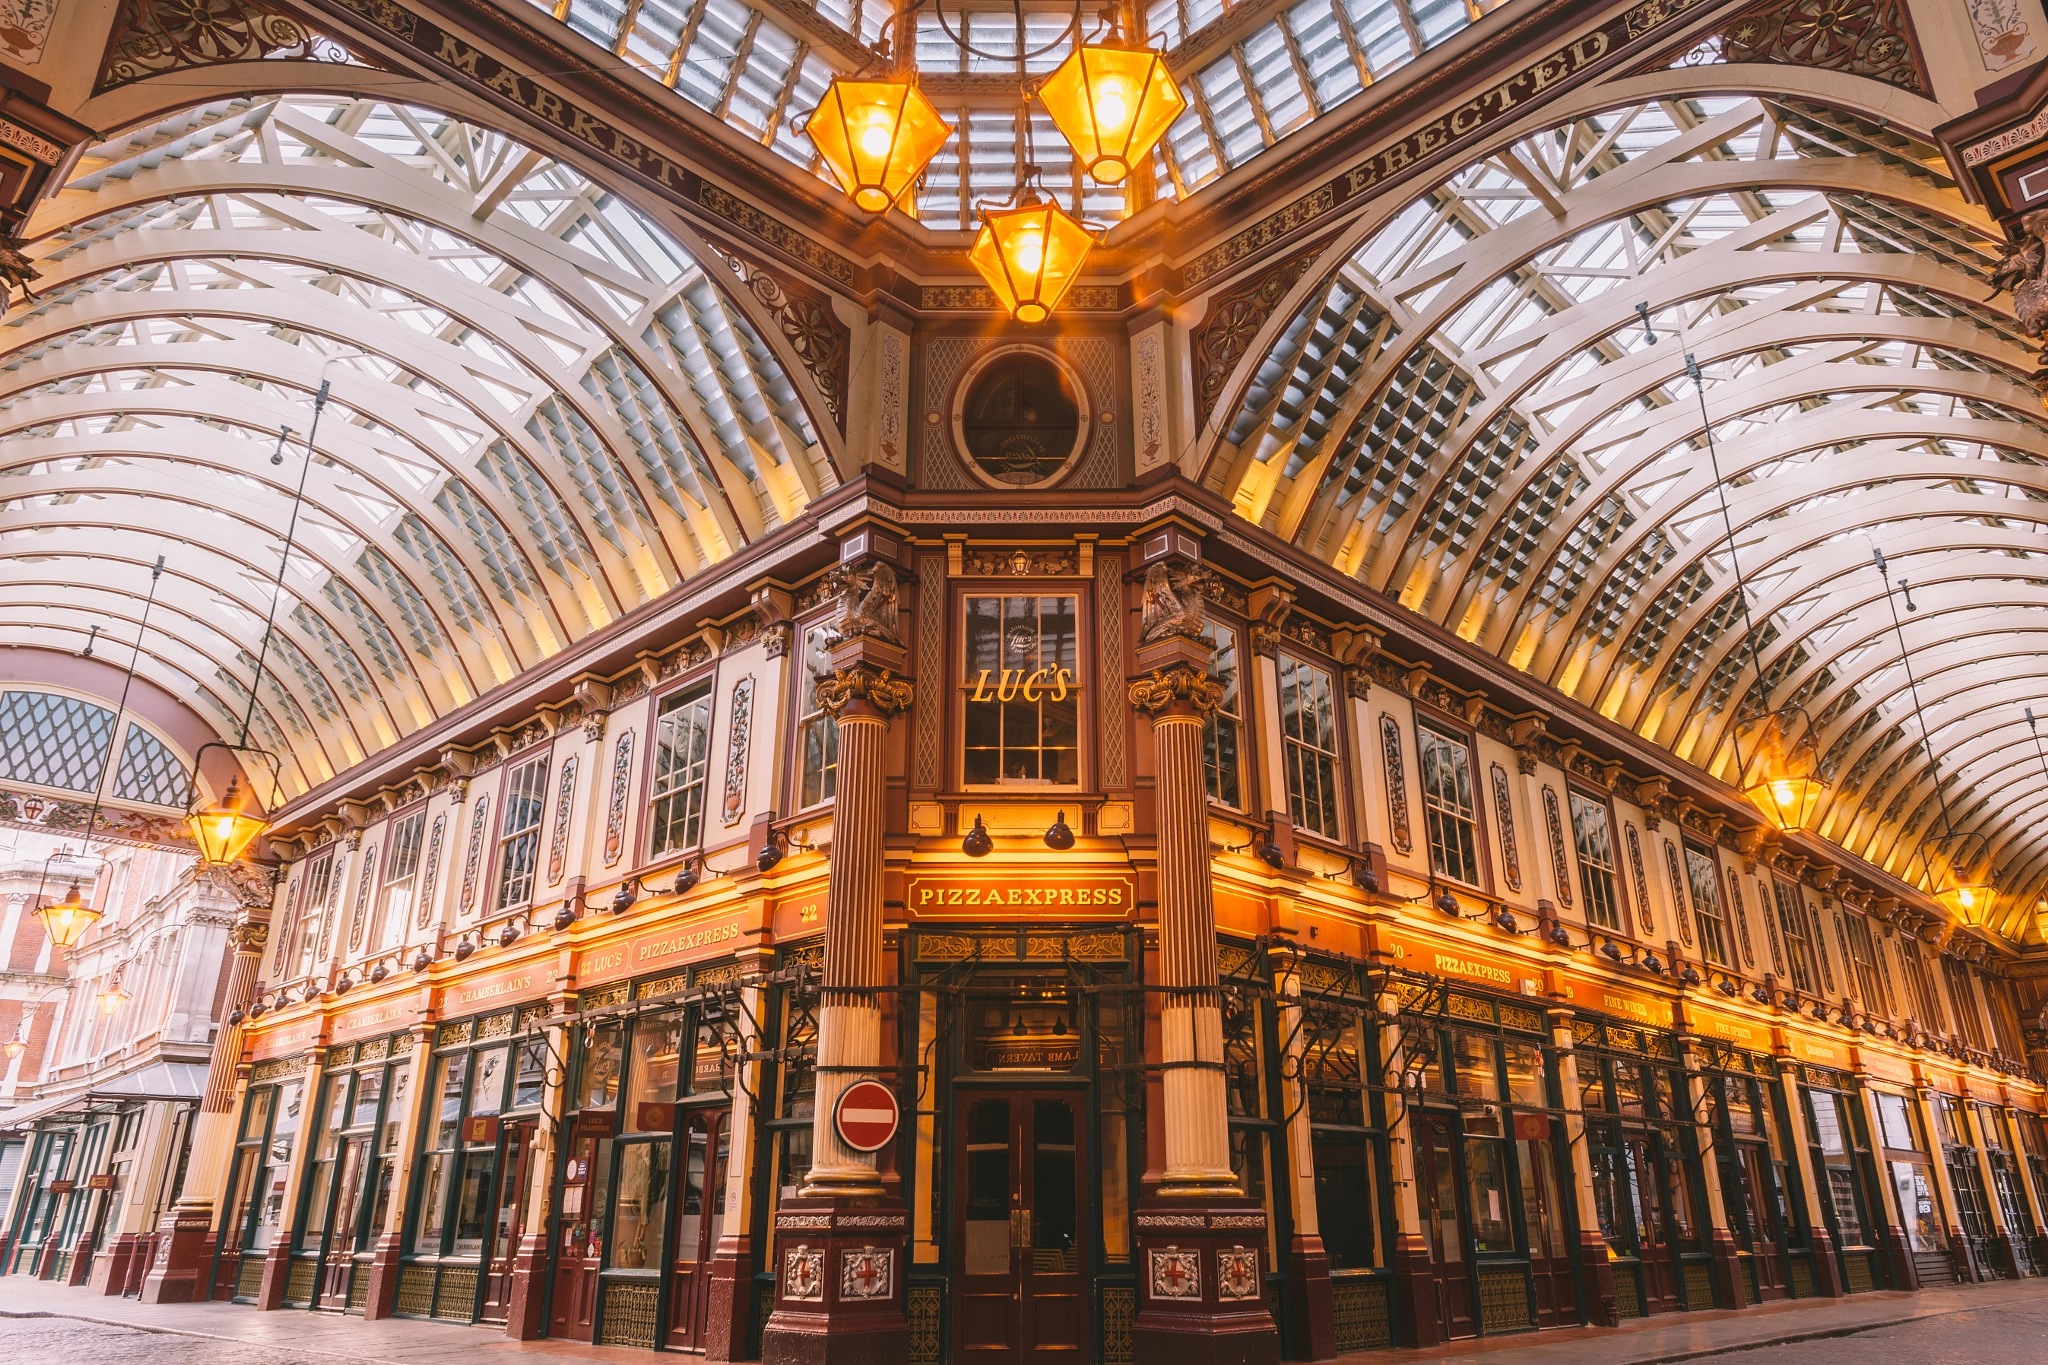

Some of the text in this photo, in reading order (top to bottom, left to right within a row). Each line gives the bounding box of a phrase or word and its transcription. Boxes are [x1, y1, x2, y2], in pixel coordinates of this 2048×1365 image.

[433, 31, 684, 187] MARKET
[1344, 31, 1609, 197] ERECTED
[970, 662, 1072, 703] LUC'S
[919, 888, 1122, 906] PIZZAEXPRESS
[801, 904, 818, 923] 22
[639, 922, 740, 962] PIZZAEXPRESS
[580, 952, 623, 977] 22 LUC'S
[1390, 943, 1404, 959] 20
[1434, 953, 1511, 985] PIZZAEXPRESS
[1532, 977, 1544, 992] 20
[438, 969, 559, 1009] 23 CHAMBERLAIN'S 23
[347, 1006, 403, 1031] CHAMBERLAIN'S
[1603, 994, 1623, 1010] FINE
[1622, 999, 1648, 1017] WINES
[1715, 1021, 1731, 1035] FINE
